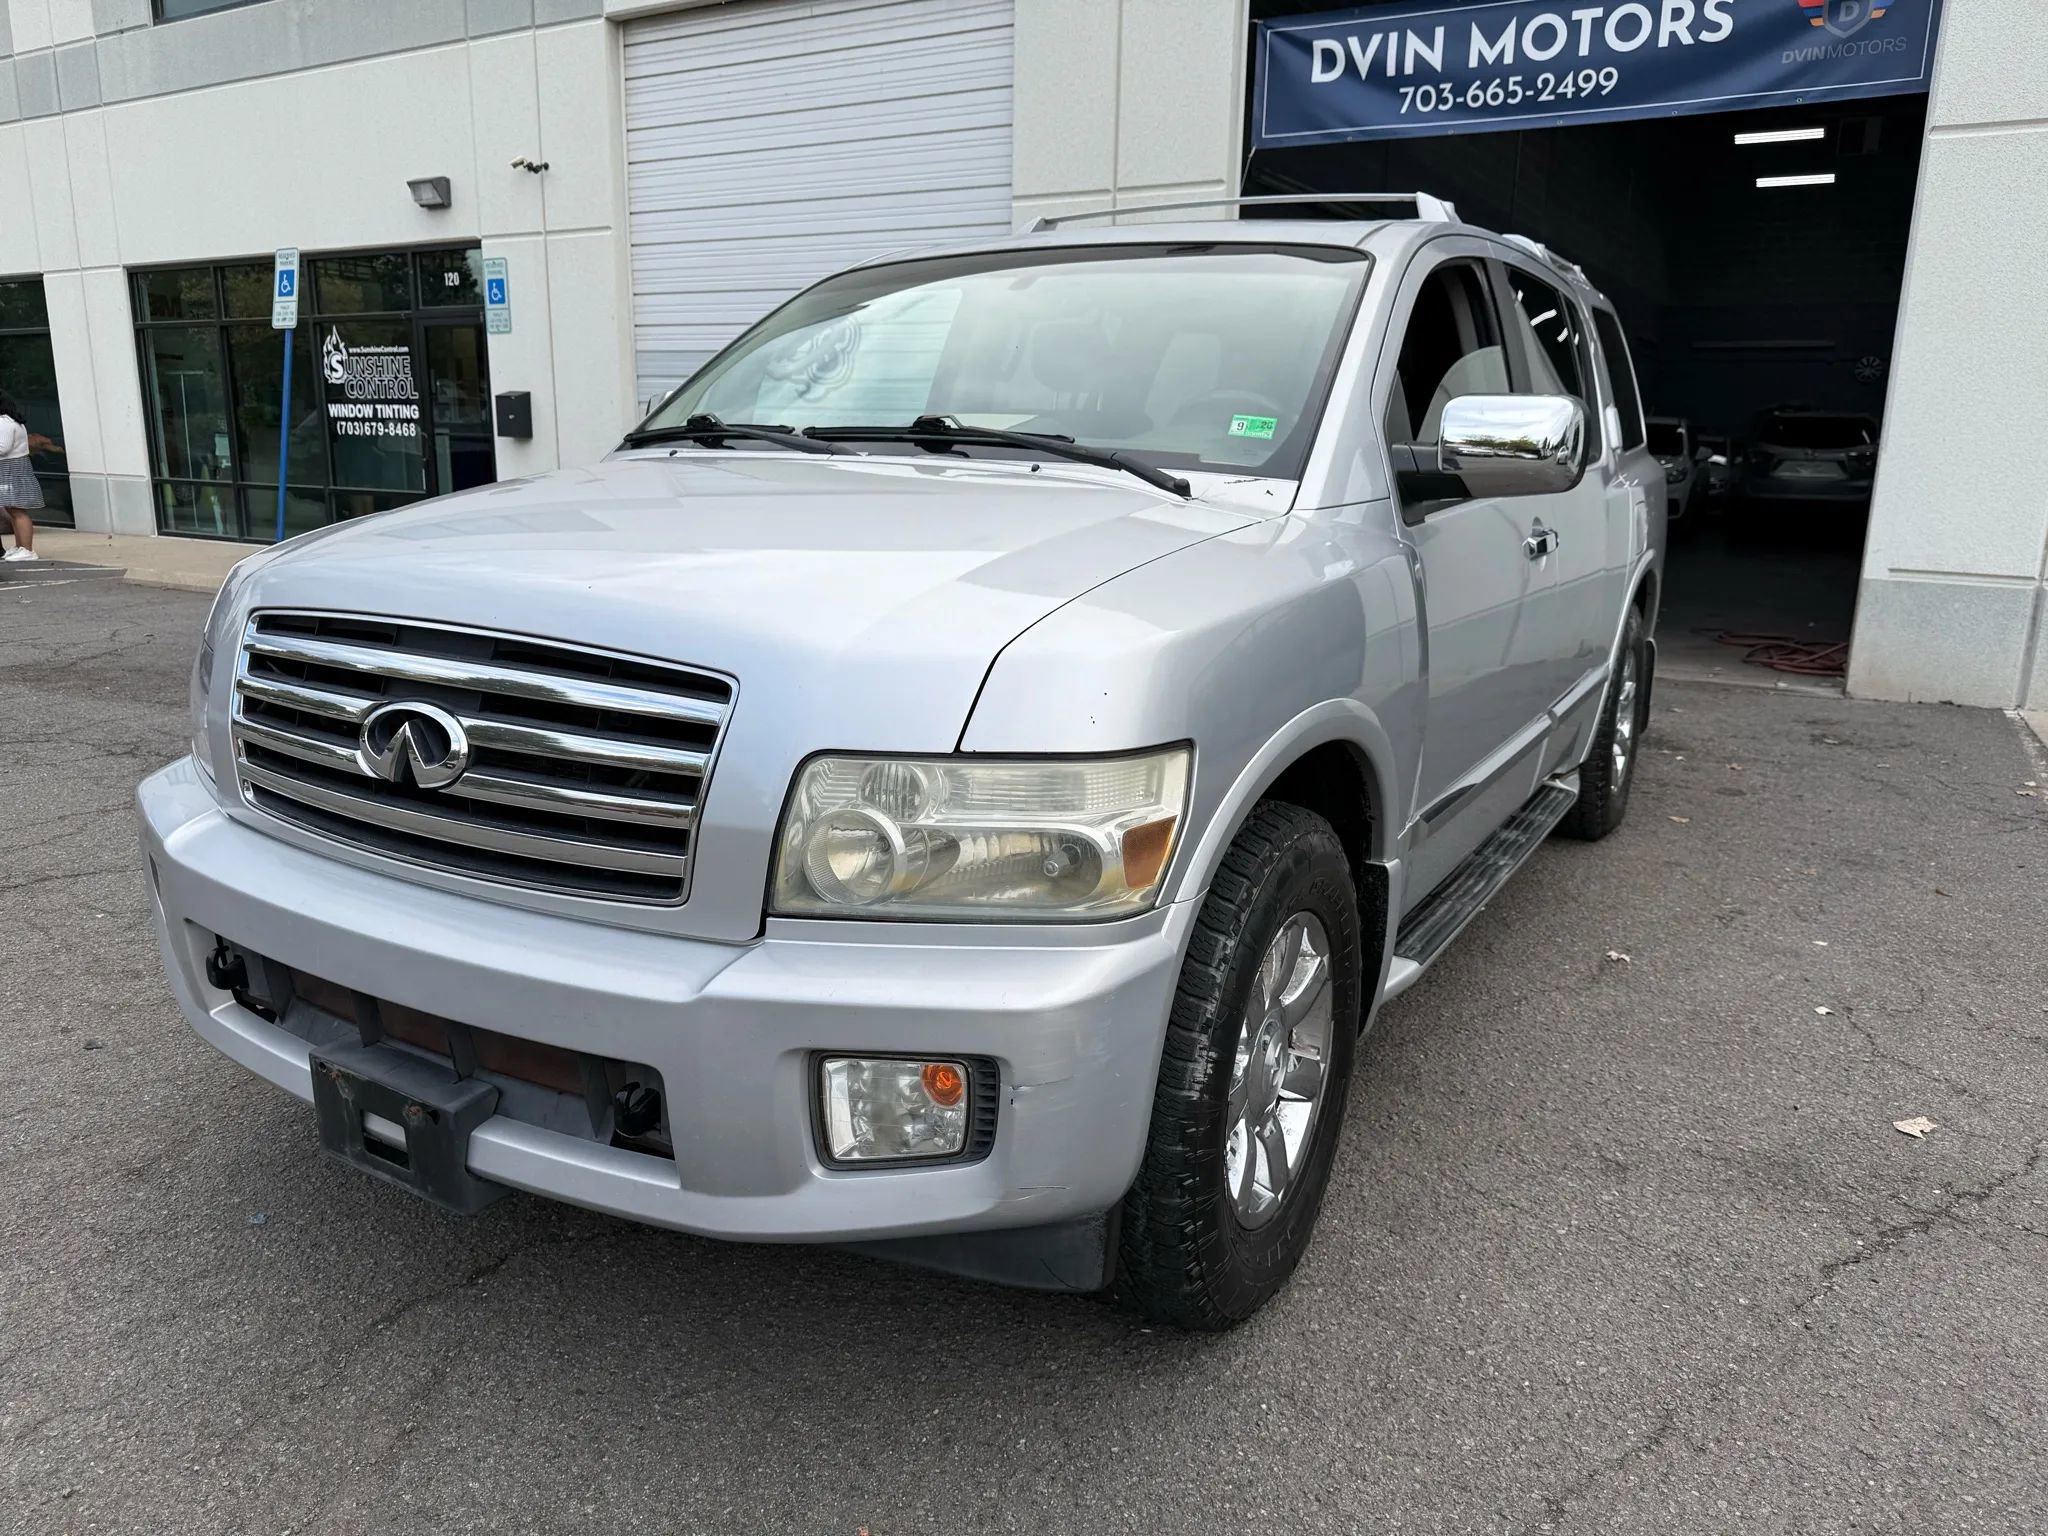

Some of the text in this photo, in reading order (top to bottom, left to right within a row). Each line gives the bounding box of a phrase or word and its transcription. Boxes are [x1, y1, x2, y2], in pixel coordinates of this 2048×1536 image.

[1311, 0, 1734, 83] DVIN MOTORS
[1399, 66, 1619, 114] 703-665-2499
[444, 272, 460, 286] 120
[330, 353, 411, 379] SUNSHINE
[345, 377, 419, 399] CONTROL
[328, 403, 419, 419] WINDOW TINTING
[336, 421, 416, 436] (703)679-8468
[1237, 422, 1244, 431] 9
